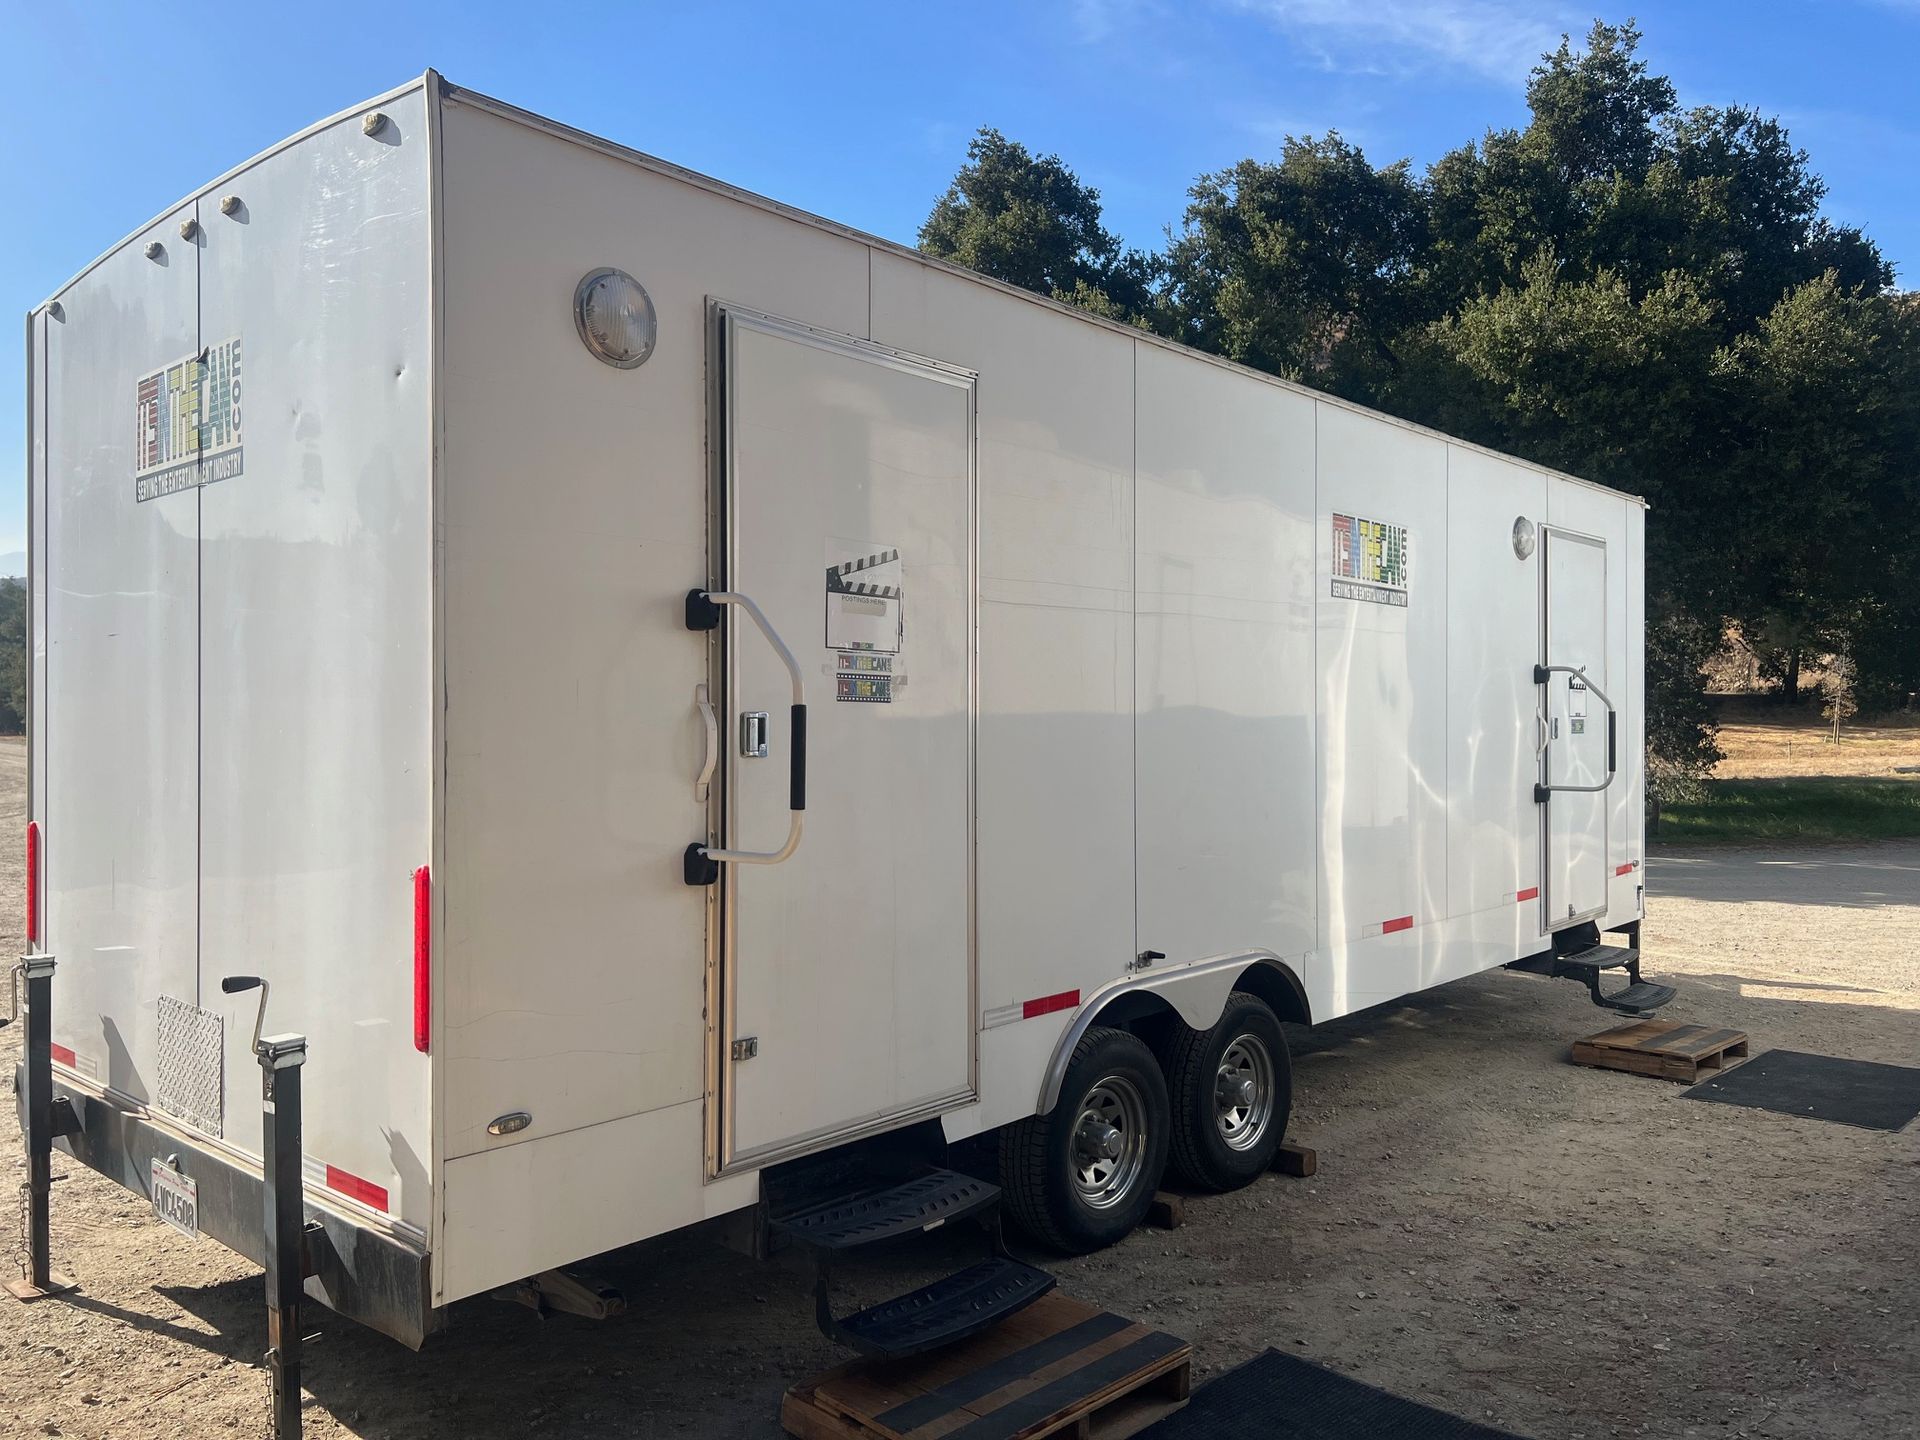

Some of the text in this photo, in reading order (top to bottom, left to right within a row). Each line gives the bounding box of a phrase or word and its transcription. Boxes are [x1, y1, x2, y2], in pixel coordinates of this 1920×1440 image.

[138, 476, 157, 502] SERVING
[158, 473, 168, 496] THE
[213, 452, 241, 480] INDUSTRY
[841, 595, 869, 604] POSTINGS
[1333, 583, 1406, 606] SERVING THE ENTERTAINMENT INDUSTRY
